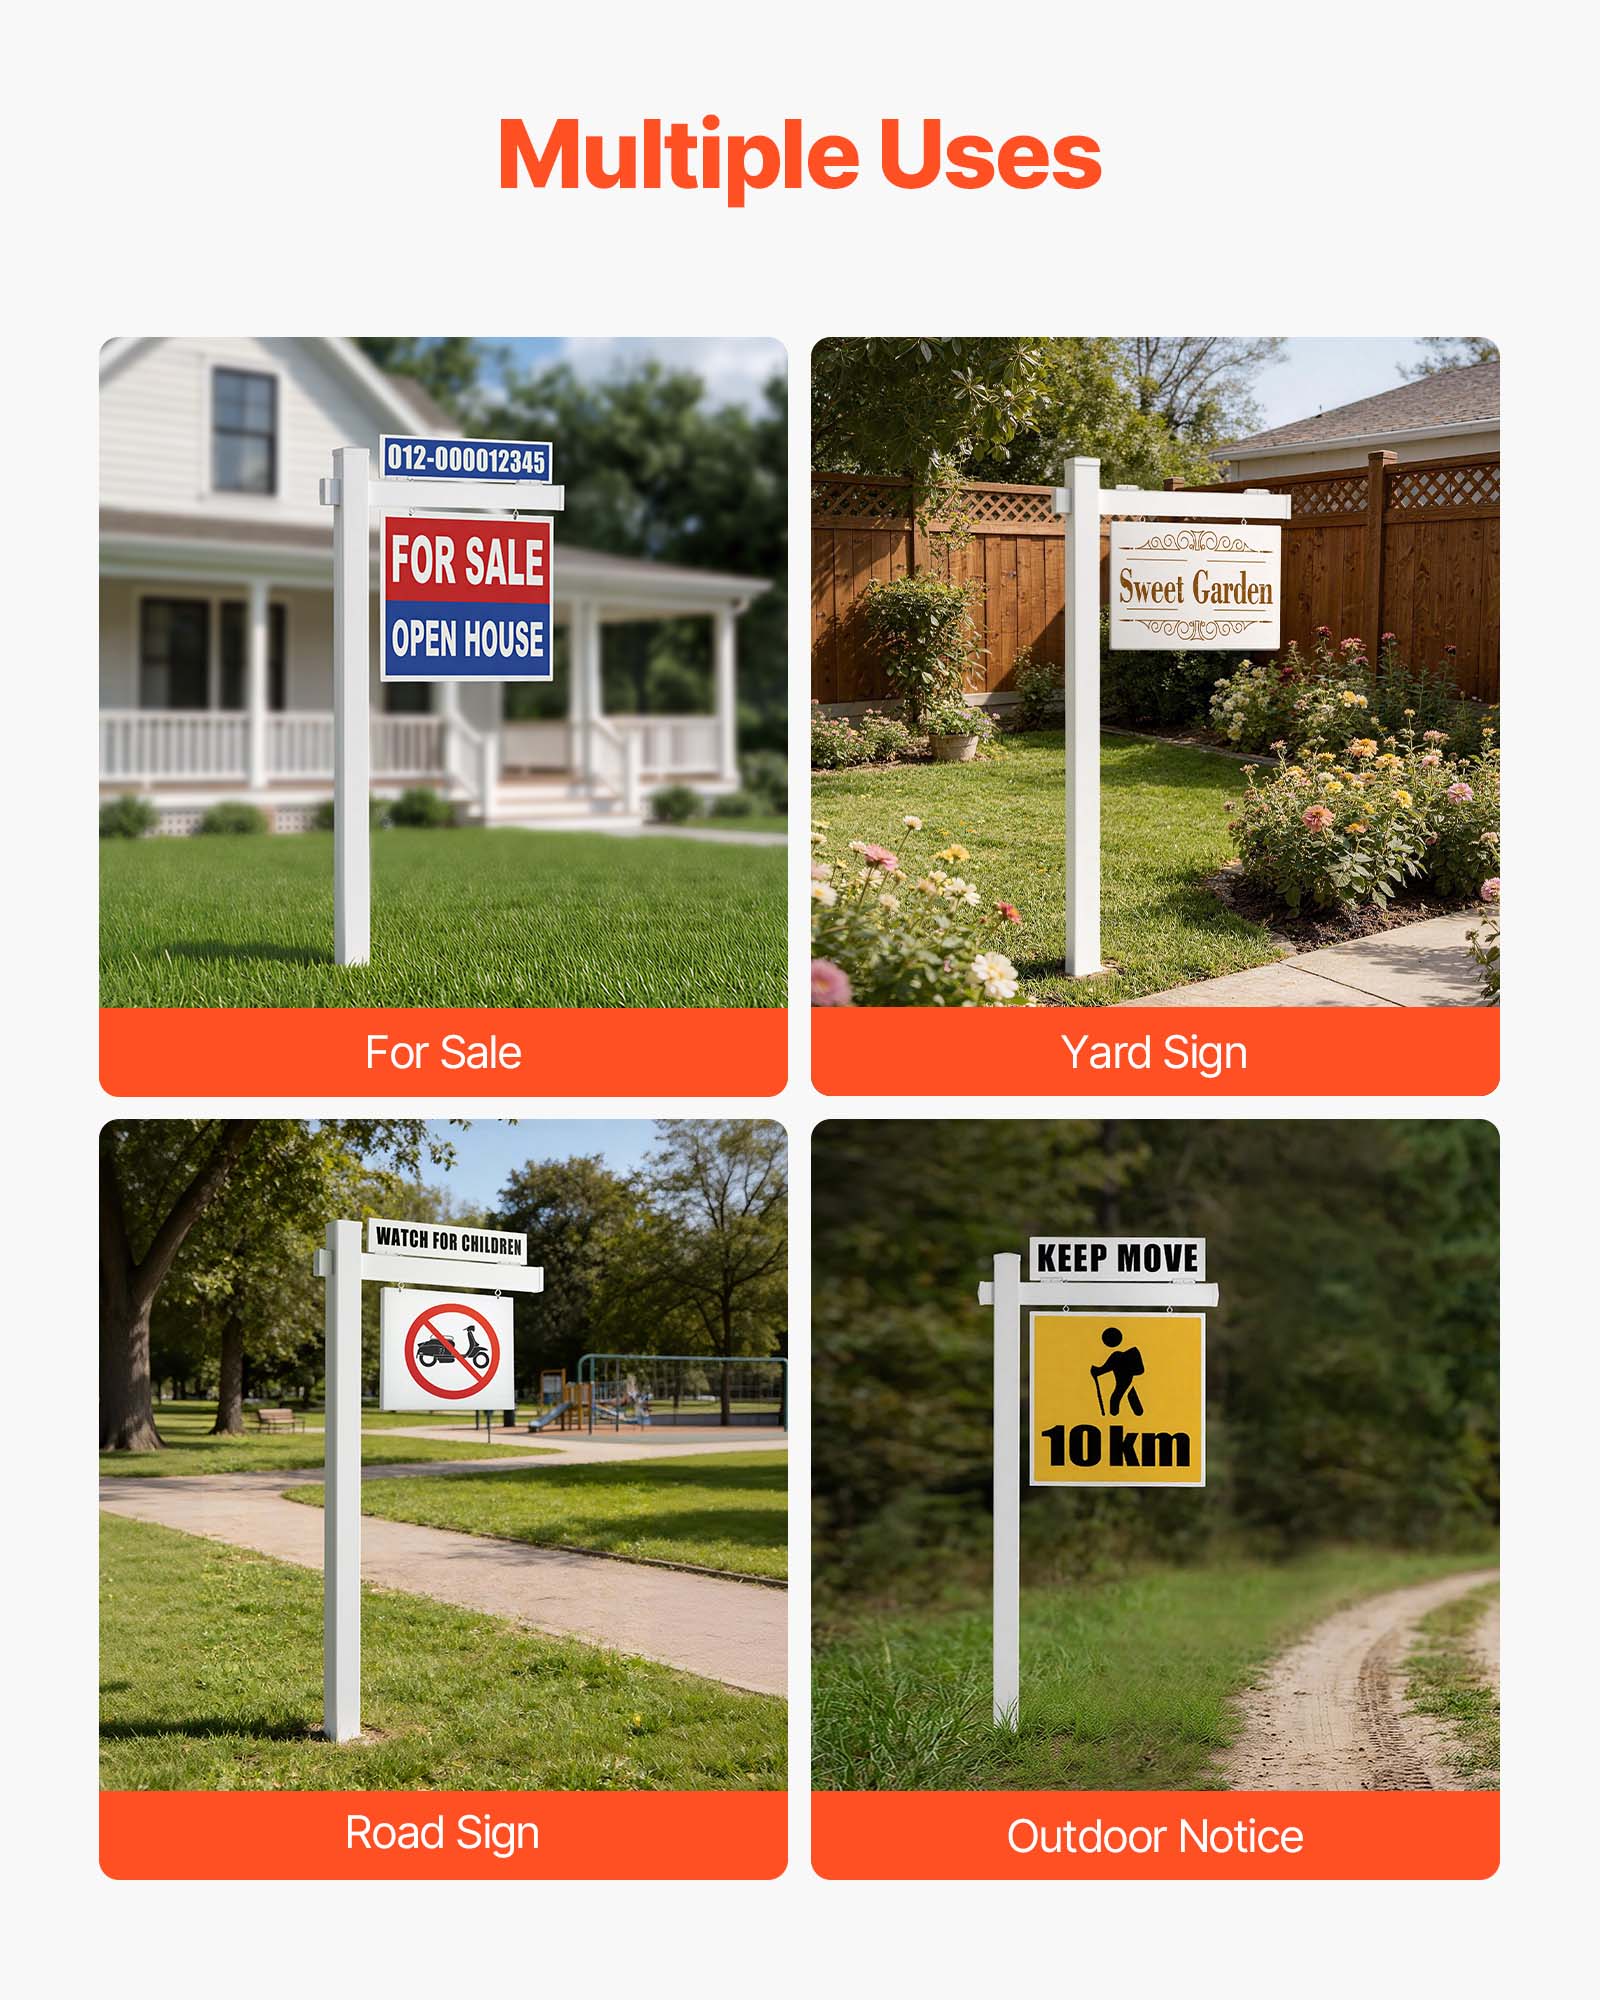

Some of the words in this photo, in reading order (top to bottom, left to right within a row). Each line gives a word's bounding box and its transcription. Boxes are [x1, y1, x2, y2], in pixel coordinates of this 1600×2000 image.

[388, 443, 545, 474] 012-000012345
[392, 534, 456, 584] FOR
[465, 536, 544, 586] SALE
[1119, 567, 1185, 604] Sweet
[1192, 569, 1273, 605] Garden
[392, 618, 457, 657] OPEN
[464, 620, 544, 658] HOUSE
[375, 1226, 428, 1249] WATCH
[432, 1231, 458, 1251] FOR
[461, 1233, 522, 1256] CHILDREN
[1037, 1243, 1107, 1273] KEEP
[1117, 1243, 1198, 1273] MOVE
[1041, 1424, 1102, 1468] 10
[1109, 1425, 1191, 1467] km
